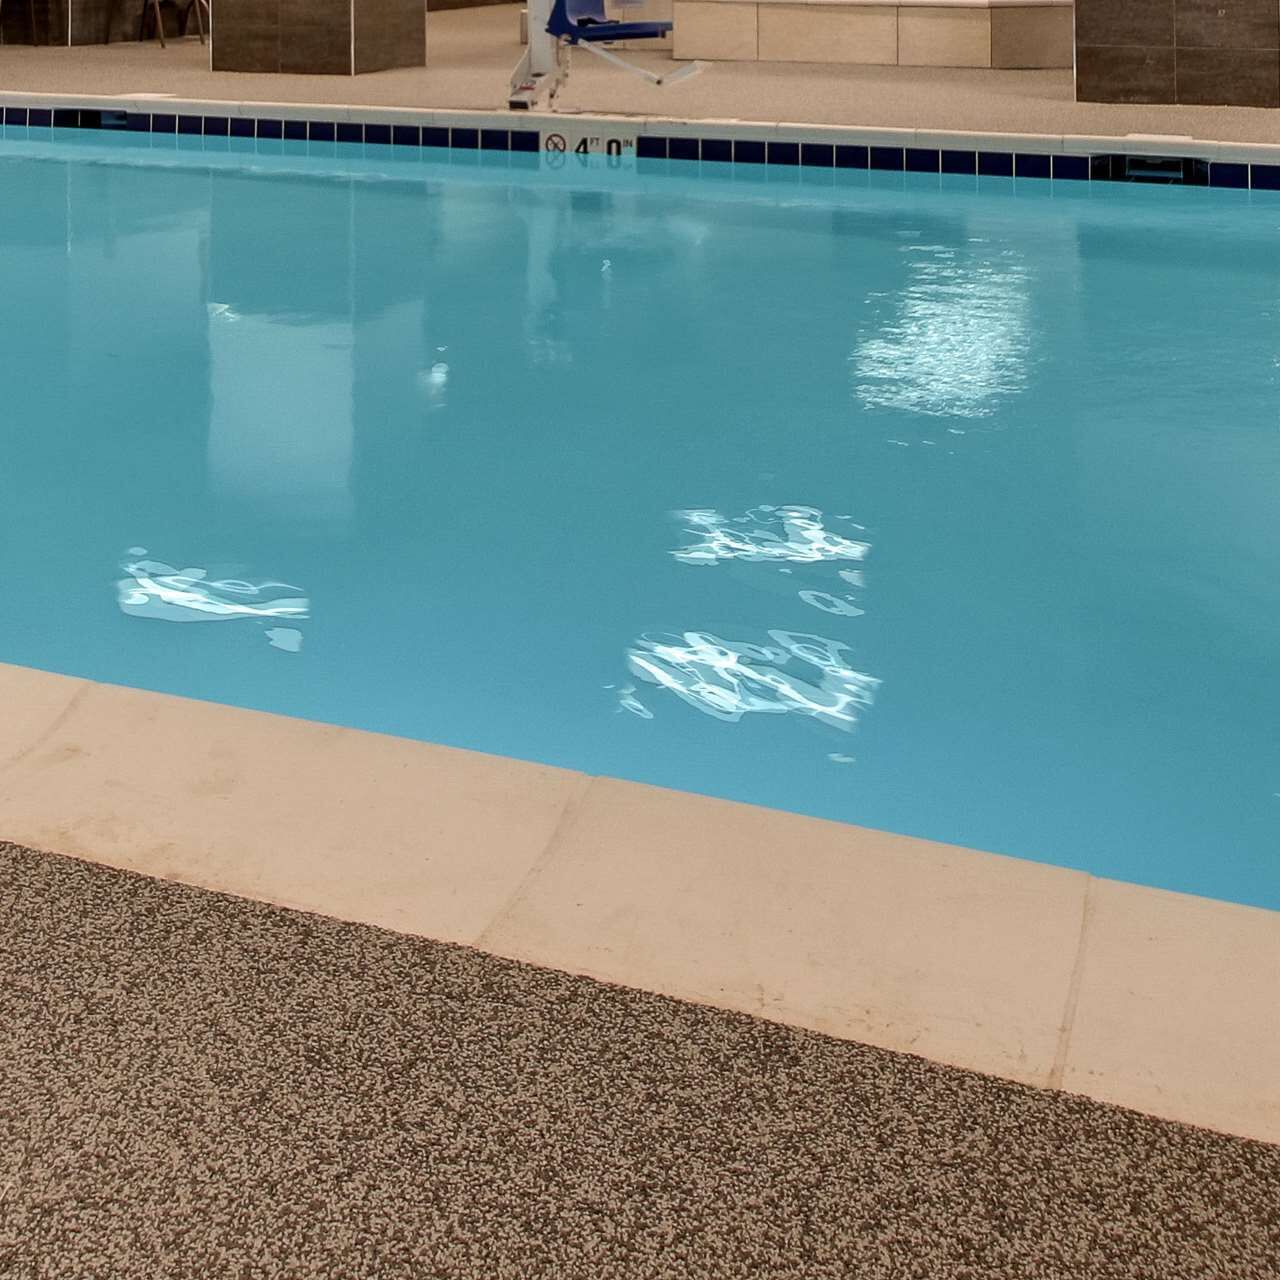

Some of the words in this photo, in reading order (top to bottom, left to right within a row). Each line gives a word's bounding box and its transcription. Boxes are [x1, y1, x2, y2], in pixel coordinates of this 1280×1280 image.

[575, 137, 589, 154] 4
[590, 137, 600, 147] FT
[607, 139, 622, 156] 0
[623, 138, 633, 147] IN
